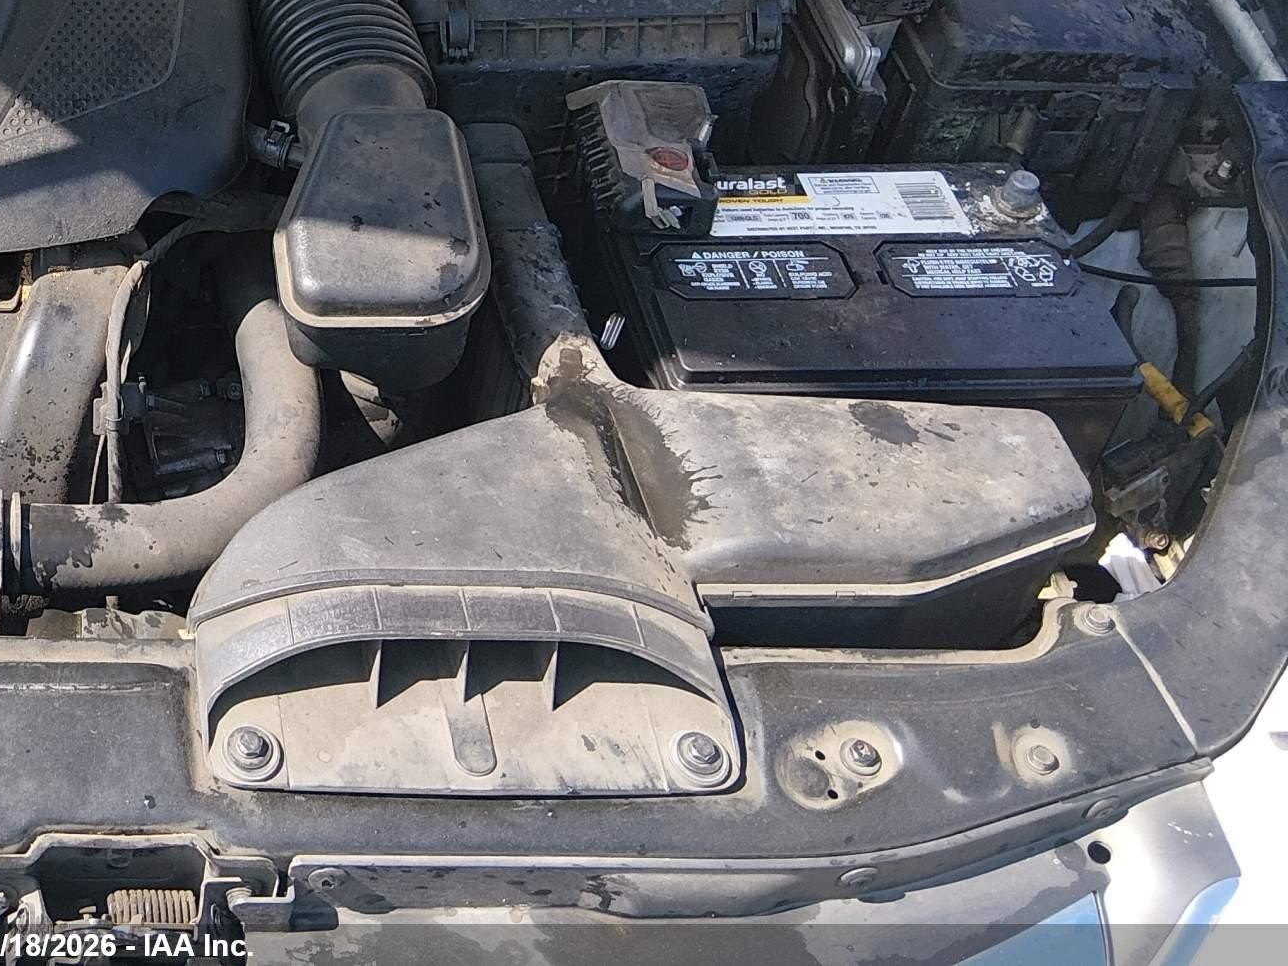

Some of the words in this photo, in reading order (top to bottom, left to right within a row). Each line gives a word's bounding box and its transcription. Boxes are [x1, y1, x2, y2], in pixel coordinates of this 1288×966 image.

[714, 176, 787, 191] uralast
[791, 212, 810, 220] 700
[702, 251, 751, 259] DANGER
[753, 250, 759, 259] /
[761, 250, 805, 258] POISON
